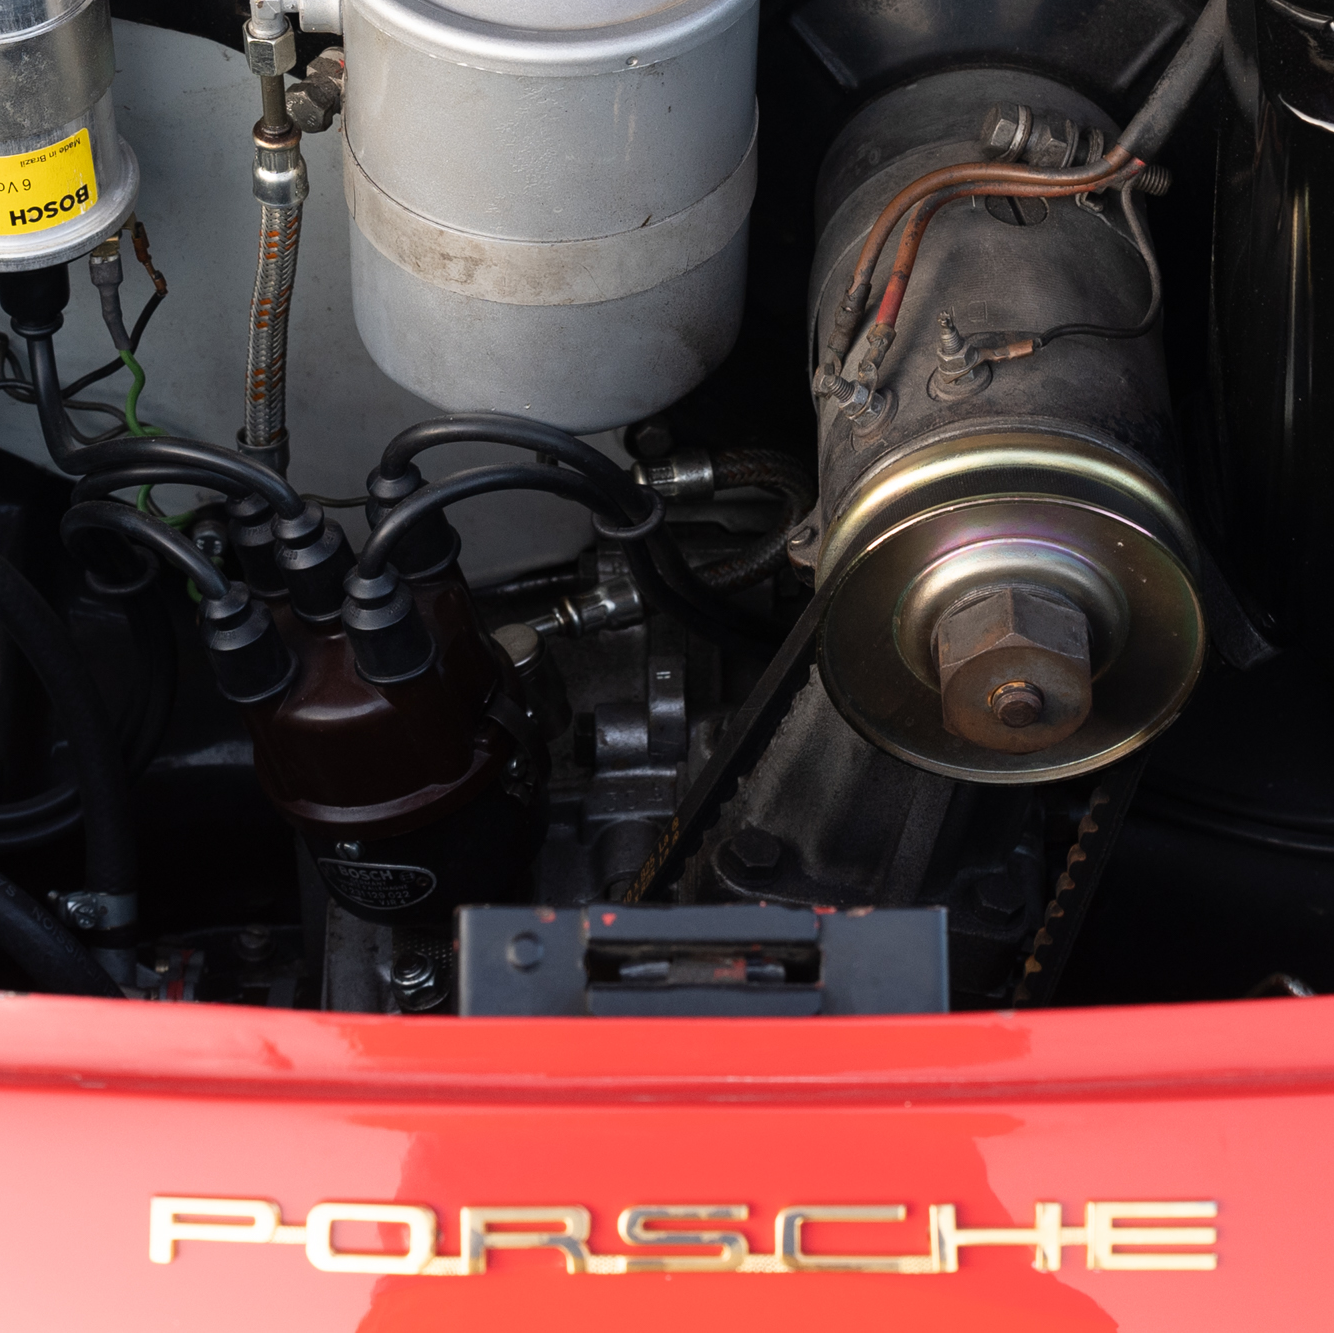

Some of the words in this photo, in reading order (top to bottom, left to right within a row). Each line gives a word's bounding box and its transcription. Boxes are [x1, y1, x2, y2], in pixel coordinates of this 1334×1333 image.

[58, 137, 81, 154] Made
[20, 154, 47, 168] Brazil
[48, 150, 58, 159] in
[22, 178, 32, 191] 6
[9, 183, 90, 226] BOSCH
[337, 865, 394, 881] BOSCH
[149, 1195, 1218, 1275] PORSCHE
